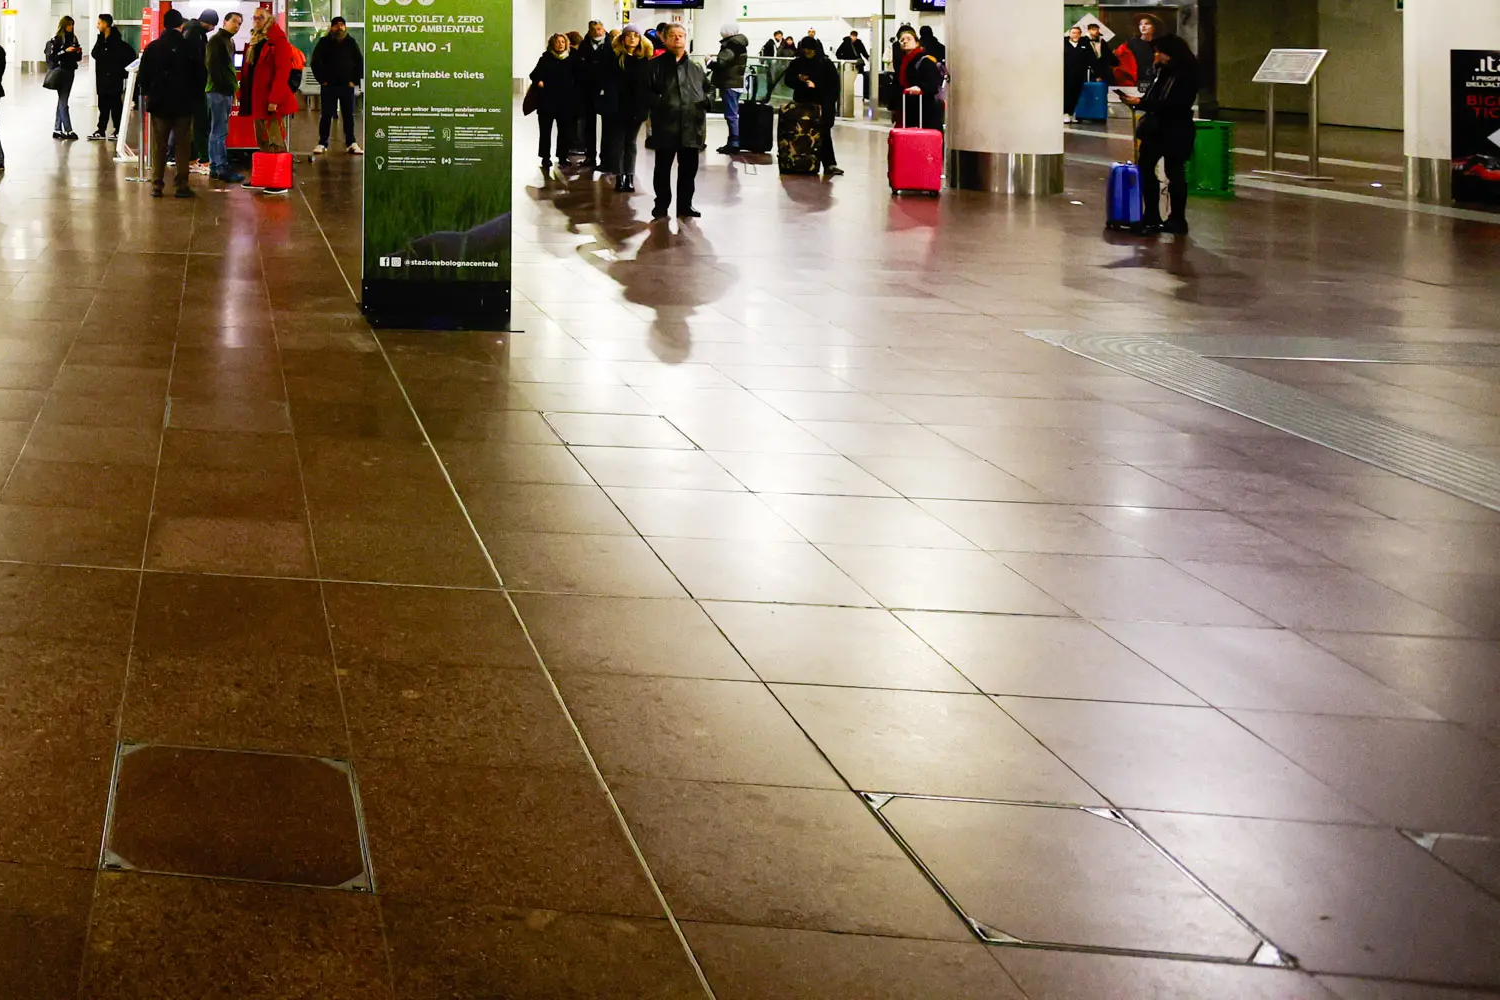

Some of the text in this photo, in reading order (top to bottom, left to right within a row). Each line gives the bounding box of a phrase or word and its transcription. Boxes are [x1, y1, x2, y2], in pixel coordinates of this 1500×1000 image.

[372, 15, 406, 23] NUOVE
[409, 15, 444, 23] TOILET
[458, 15, 484, 23] ZERO
[420, 25, 484, 33] AMBIENTALE
[372, 42, 452, 52] AL PIANO -1
[372, 70, 484, 79] New sustainable toilets
[386, 80, 409, 88] floor
[412, 80, 420, 88] -1
